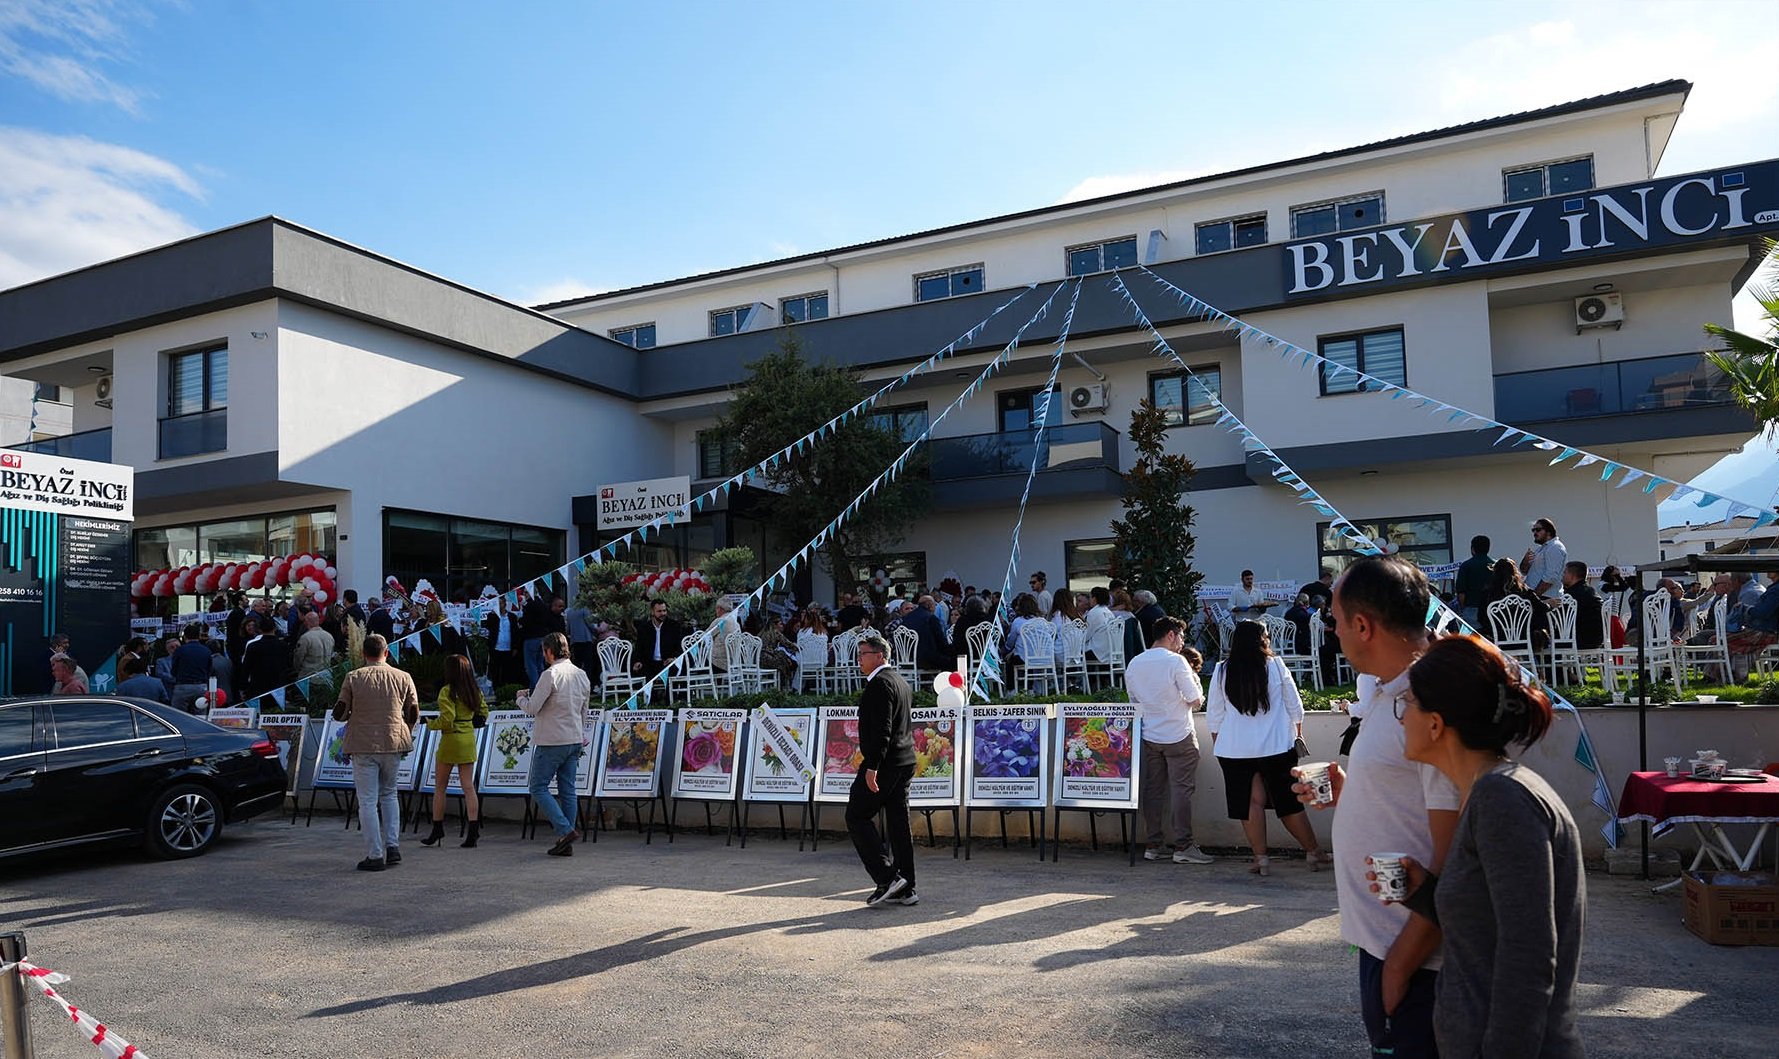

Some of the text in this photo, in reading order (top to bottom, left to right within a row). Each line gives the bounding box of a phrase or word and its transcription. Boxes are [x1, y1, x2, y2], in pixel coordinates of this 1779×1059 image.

[1286, 207, 1540, 294] BEYAZ
[0, 470, 75, 495] BEYAZ
[84, 499, 124, 512] Polikliniği
[602, 496, 647, 514] BEYAZ
[74, 520, 121, 531] HEKİMLERİMİZ
[12, 588, 26, 596] 410
[26, 588, 35, 596] 16
[35, 589, 43, 597] 16
[827, 709, 855, 717] LOKMAN
[973, 708, 998, 717] BELKIS
[1002, 708, 1026, 716] ZAFER
[1026, 707, 1047, 716] SINIK
[262, 715, 302, 724] EROL OPTİK
